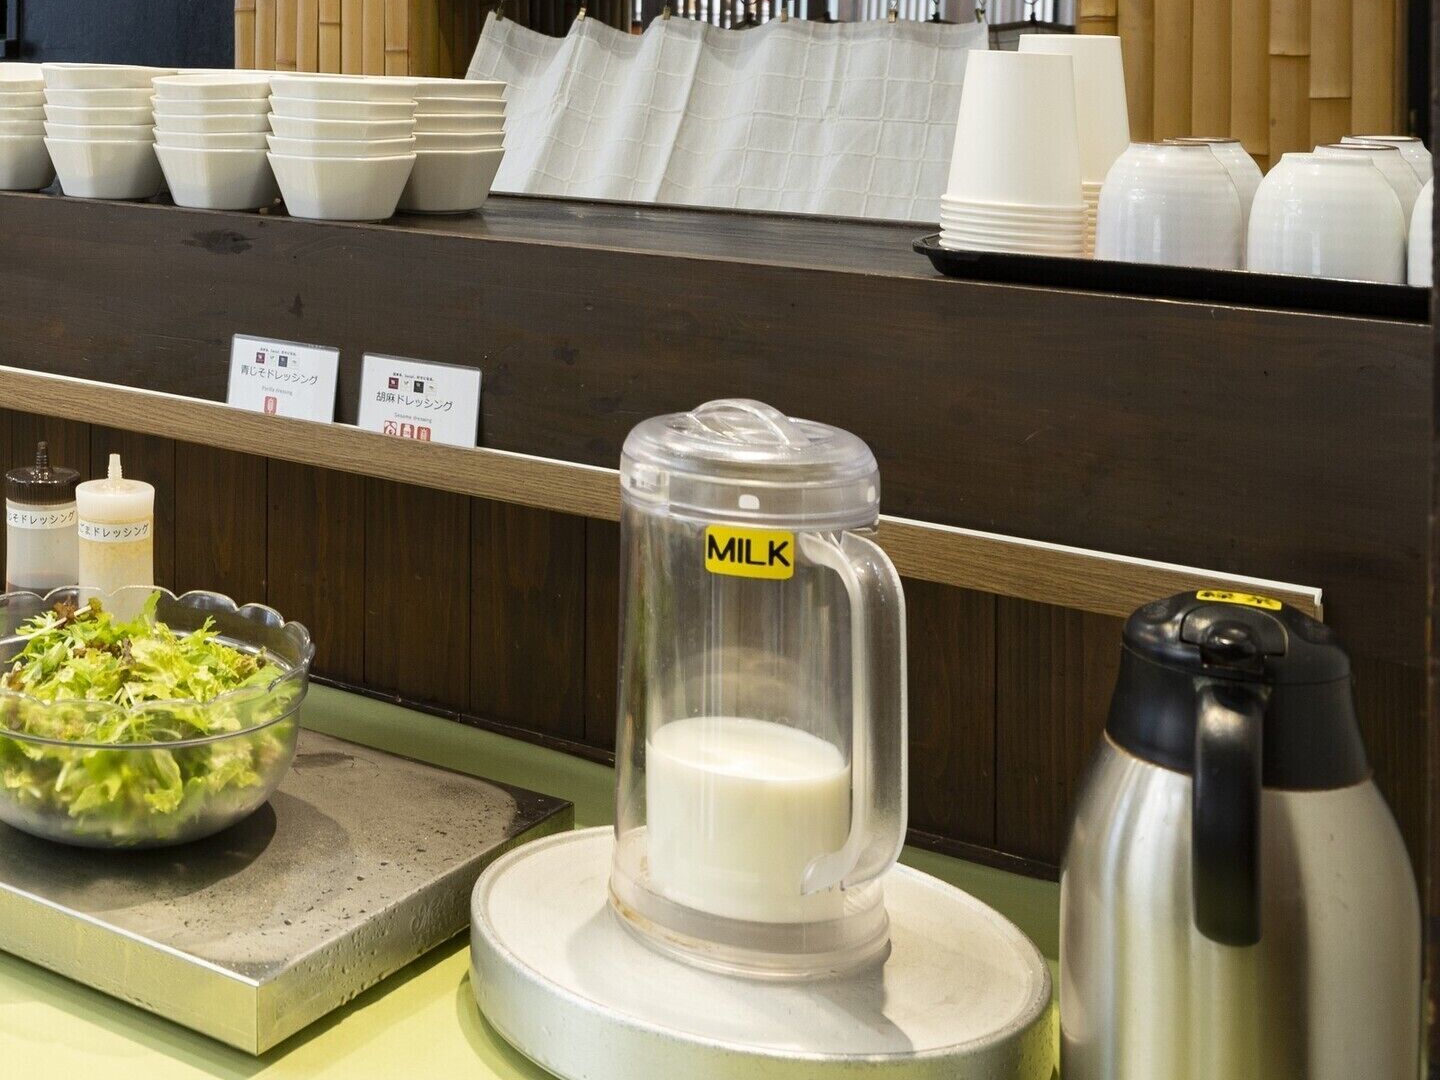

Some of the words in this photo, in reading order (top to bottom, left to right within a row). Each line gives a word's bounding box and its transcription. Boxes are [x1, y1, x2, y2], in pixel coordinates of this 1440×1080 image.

[240, 364, 318, 387] 青じそドレッシング
[376, 390, 455, 412] 胡麻ドレッシング
[707, 533, 791, 568] MILK
